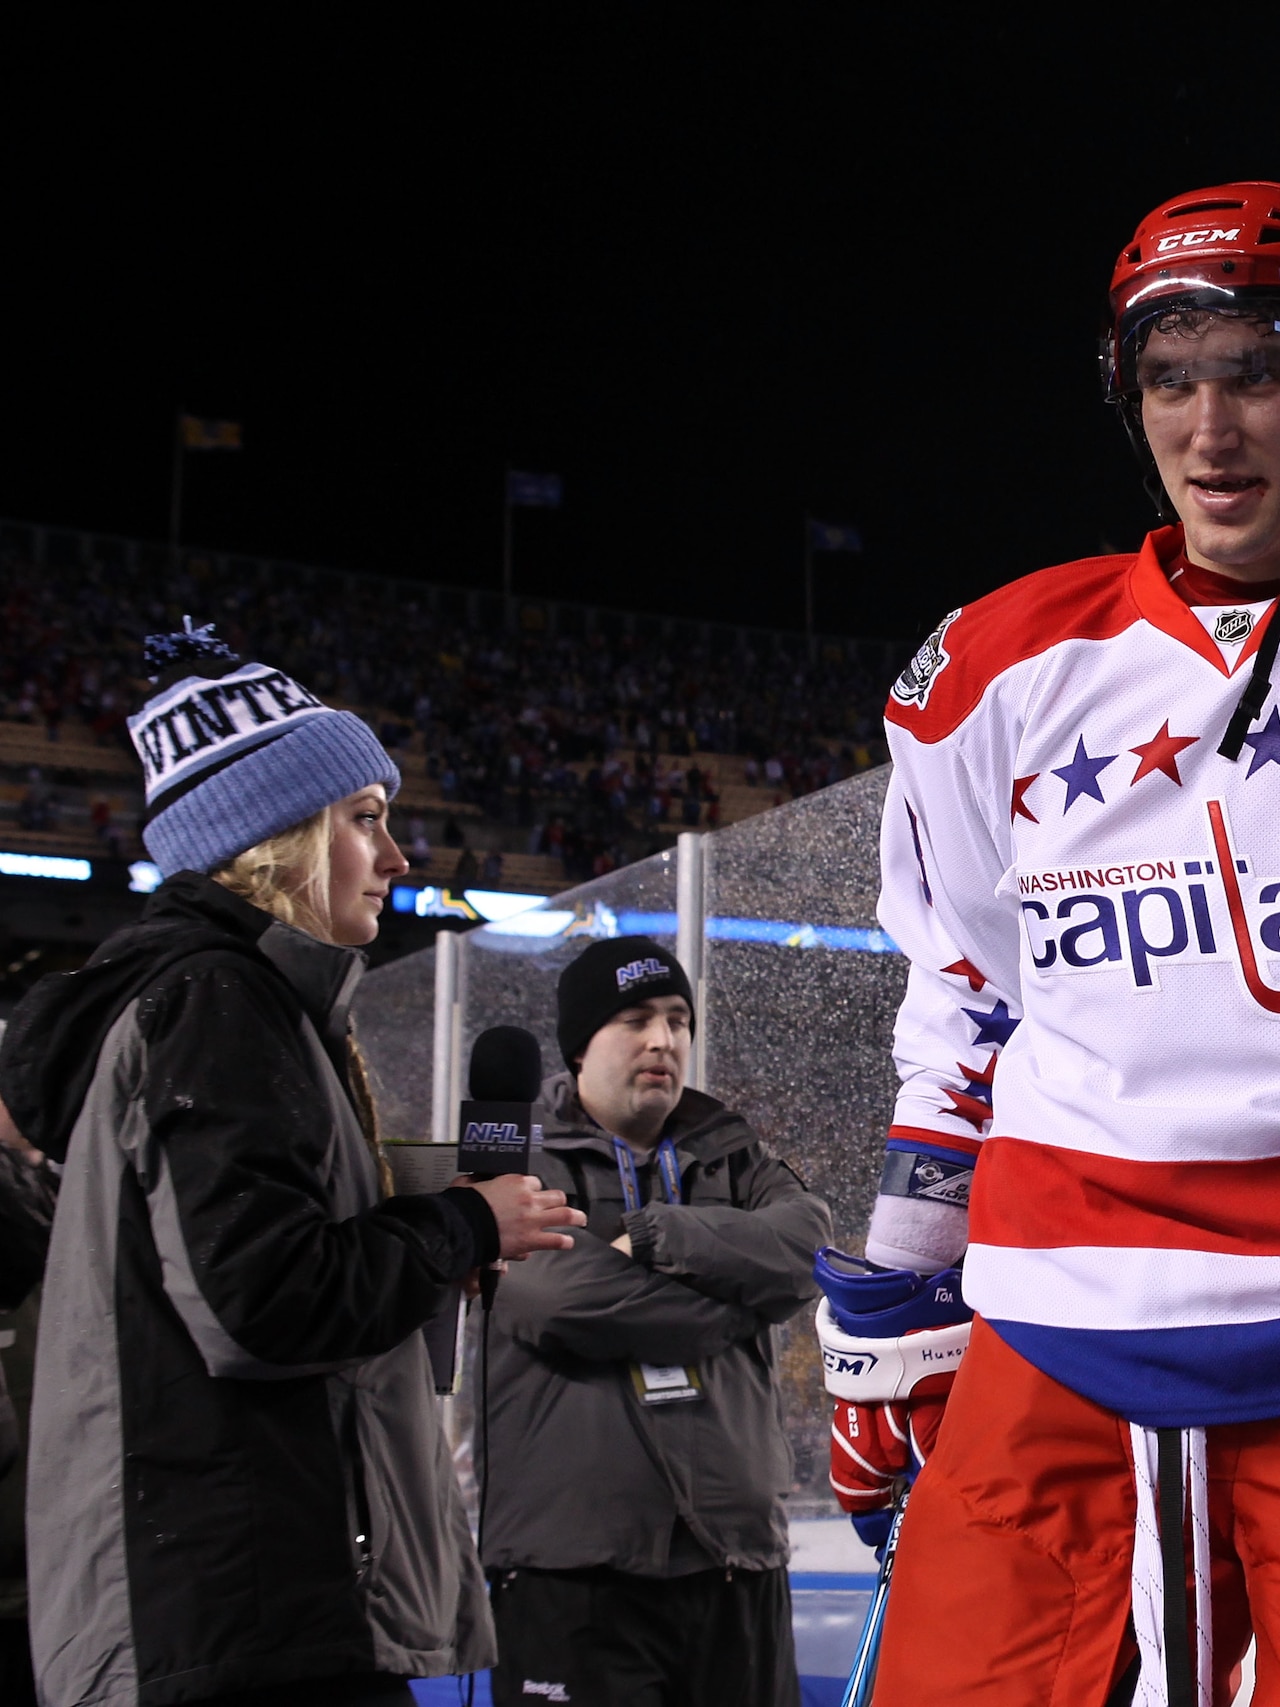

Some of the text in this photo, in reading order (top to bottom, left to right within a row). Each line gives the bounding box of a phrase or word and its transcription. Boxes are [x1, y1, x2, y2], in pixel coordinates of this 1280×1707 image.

[1157, 229, 1240, 251] CCM
[1221, 616, 1247, 637] NHL
[1017, 860, 1177, 895] WASHINGTON
[616, 958, 670, 986] NHL
[463, 1122, 527, 1144] NHL
[461, 1144, 524, 1153] NETWORK
[823, 1351, 865, 1376] CM
